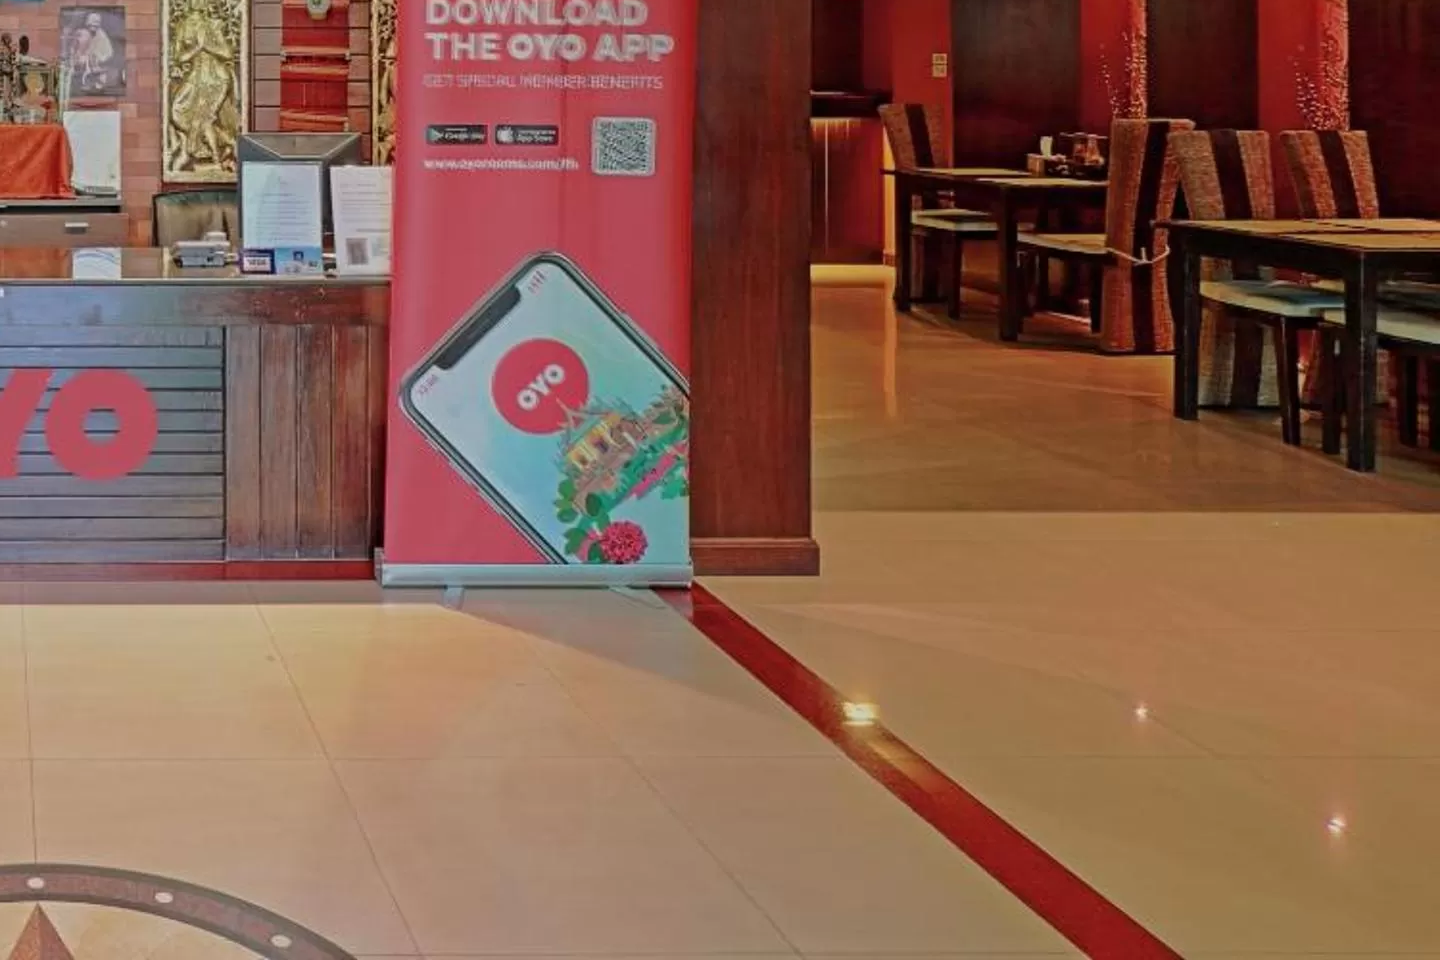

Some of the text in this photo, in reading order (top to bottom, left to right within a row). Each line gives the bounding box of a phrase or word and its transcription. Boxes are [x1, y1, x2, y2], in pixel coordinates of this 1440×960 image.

[424, 32, 675, 63] THE OYO APP
[423, 73, 664, 89] GET SPECIAL MEMBER BENEFITS
[517, 363, 566, 411] OYO
